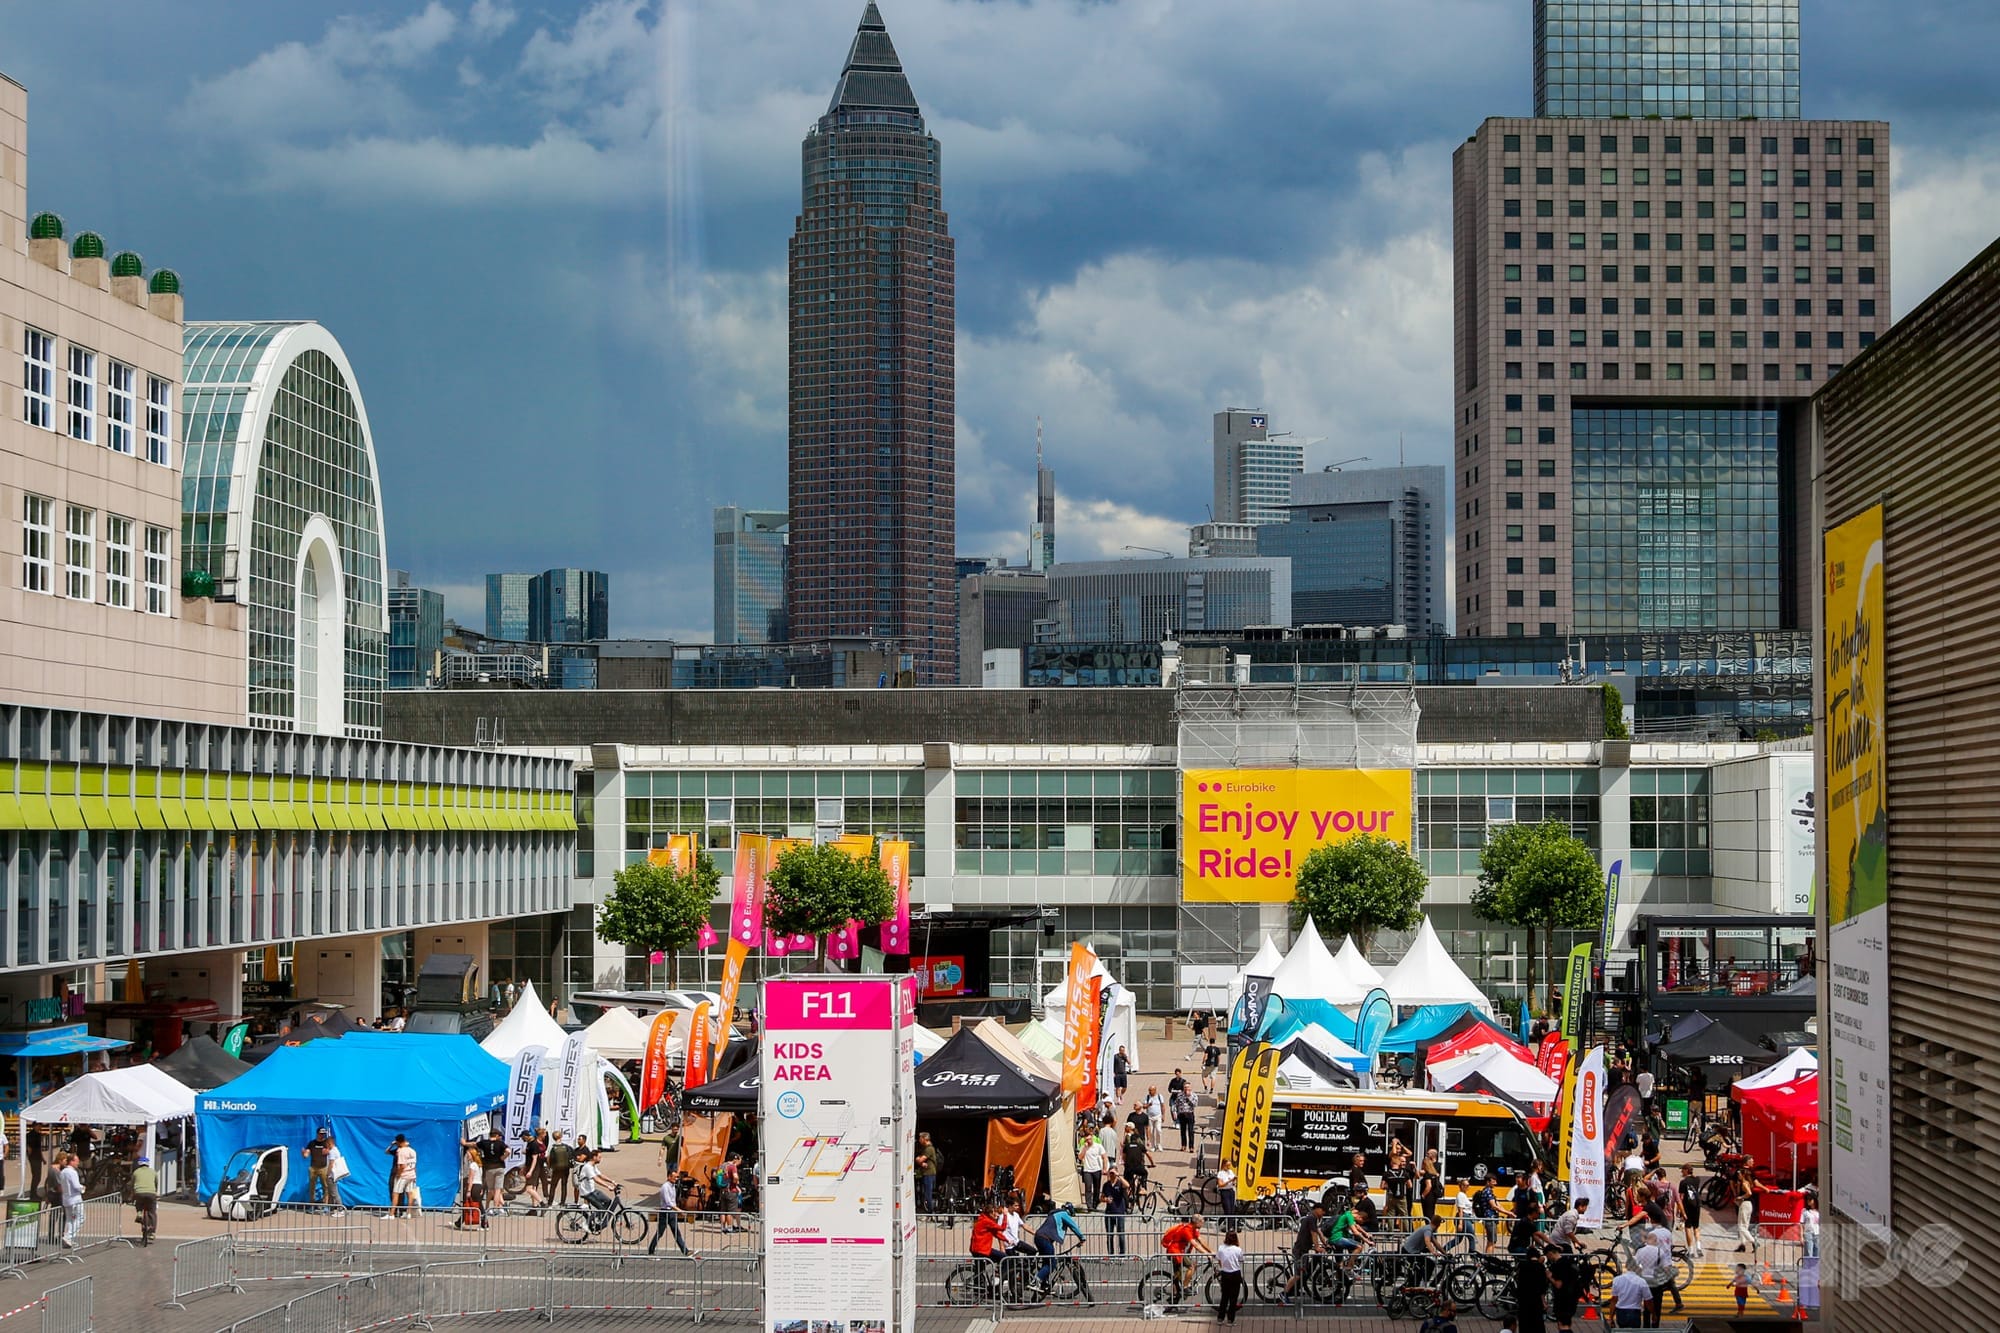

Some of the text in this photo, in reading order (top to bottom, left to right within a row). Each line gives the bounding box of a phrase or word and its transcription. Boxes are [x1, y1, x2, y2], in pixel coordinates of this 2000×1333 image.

[1831, 608, 1871, 680] Go Healthy
[1830, 688, 1872, 776] Taiwan
[1226, 783, 1276, 792] Eurobike
[1199, 802, 1394, 840] Enjoy your
[1199, 848, 1292, 878] Ride!
[743, 847, 756, 916] Eurobike.com
[28, 996, 62, 1023] CHURROS
[802, 992, 856, 1018] F11
[1065, 962, 1086, 1067] HASE
[651, 1023, 667, 1079] RIDE IN STYLE
[693, 1015, 705, 1068] RIDE IN STYLE
[773, 1043, 823, 1059] KIDS
[560, 1038, 580, 1121] KLEUSTER
[773, 1064, 832, 1081] AREA
[925, 1071, 1001, 1085] HASE
[221, 1100, 257, 1111] Mando
[510, 1052, 536, 1141] KLEUSTER
[1585, 1080, 1594, 1133] BAFANG
[1245, 1084, 1265, 1188] GUSTO
[1303, 1123, 1348, 1131] GUSTO
[1574, 1167, 1594, 1176] Drive
[1575, 1158, 1598, 1167] E-Bike
